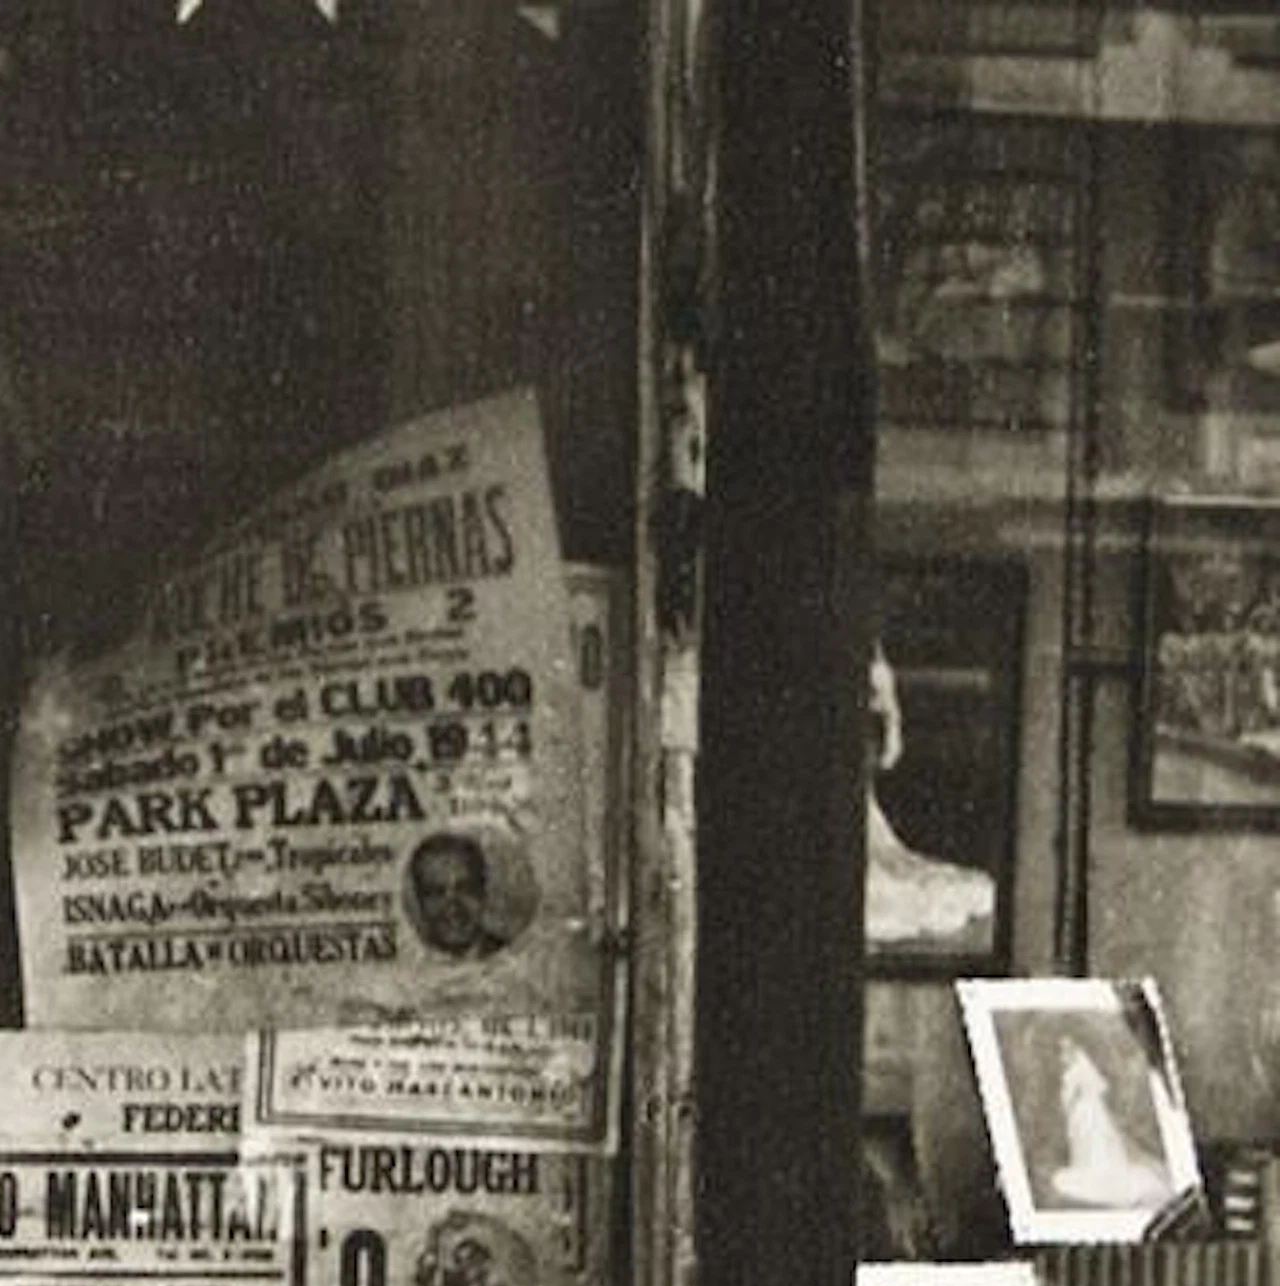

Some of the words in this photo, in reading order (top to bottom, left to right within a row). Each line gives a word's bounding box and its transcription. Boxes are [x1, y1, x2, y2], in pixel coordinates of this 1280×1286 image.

[446, 587, 477, 622] 2
[274, 689, 309, 722] el
[320, 673, 436, 717] CLUB
[447, 667, 533, 709] 400
[259, 734, 309, 770] de
[55, 784, 219, 844] PARK
[233, 767, 427, 831] PLAZA
[62, 849, 131, 880] JOSE
[63, 935, 204, 975] BATALLA
[32, 1065, 171, 1093] CENTRO
[319, 1145, 540, 1195] FURLOUGH
